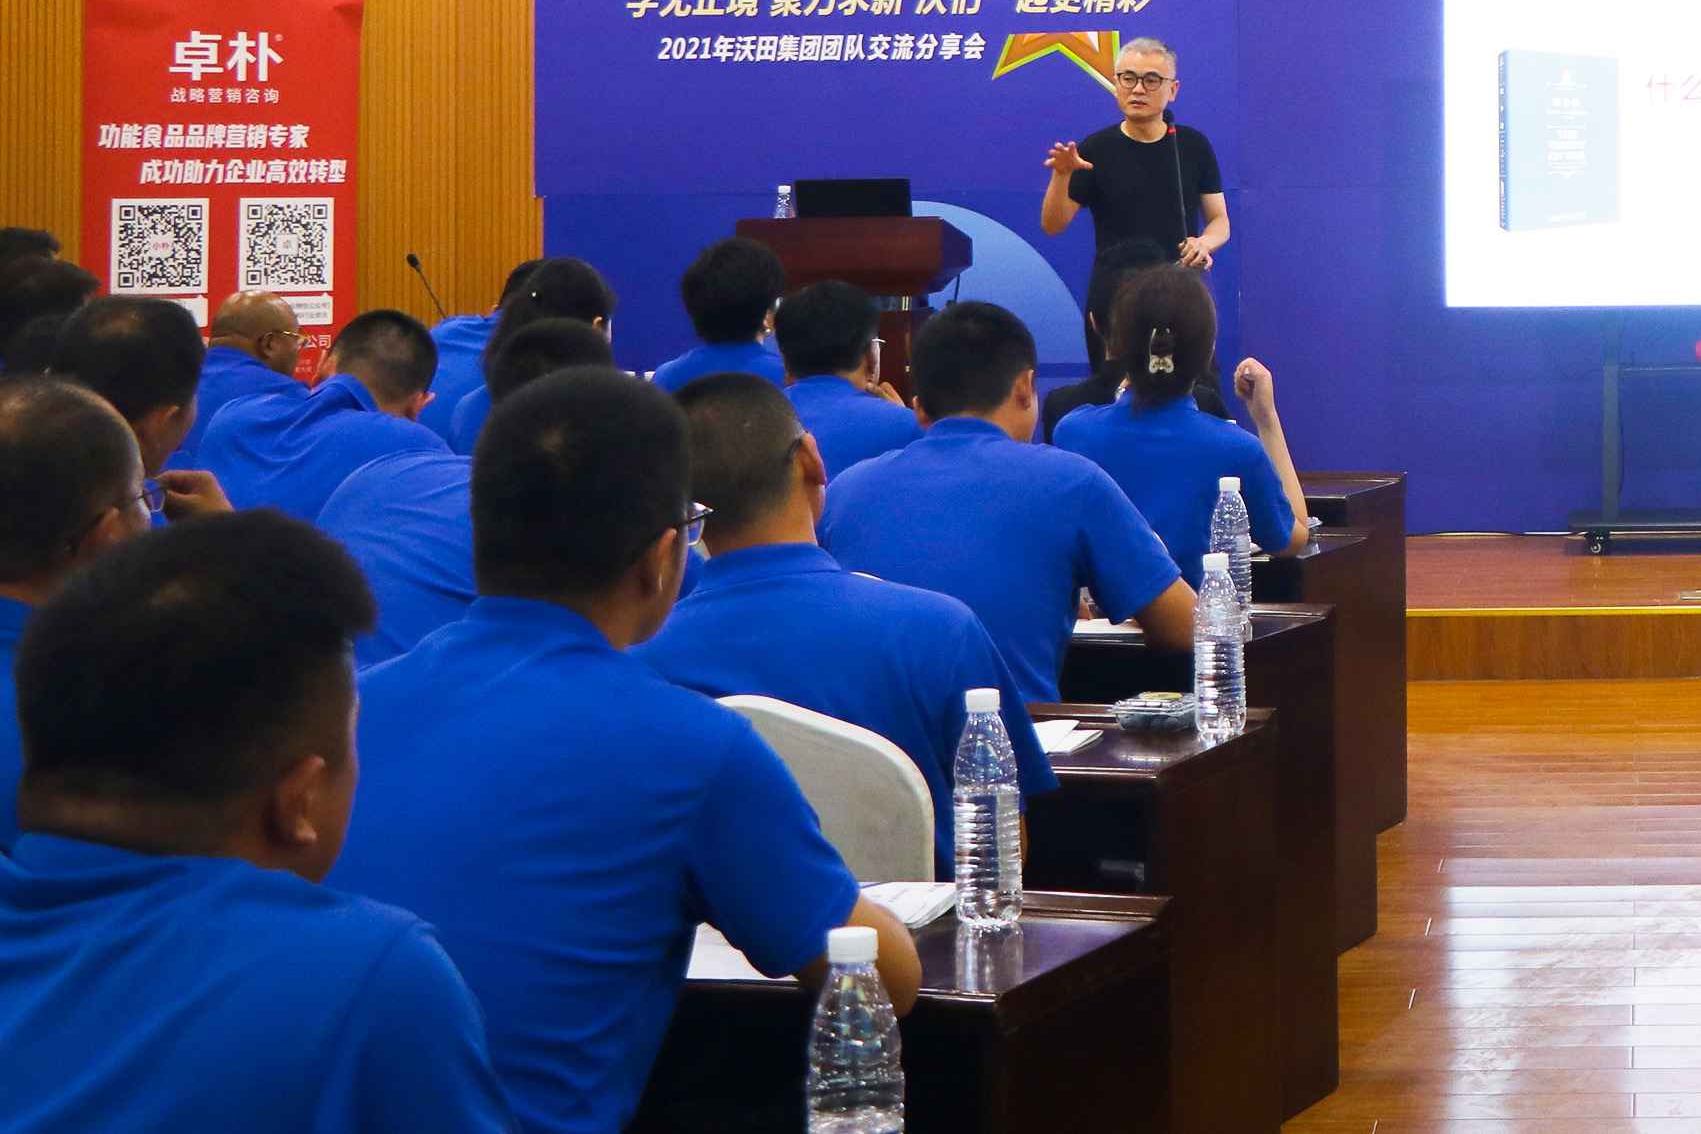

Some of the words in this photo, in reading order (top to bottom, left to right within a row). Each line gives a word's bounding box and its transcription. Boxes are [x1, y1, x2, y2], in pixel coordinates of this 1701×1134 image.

[169, 31, 284, 82] 卓朴
[657, 32, 987, 63] 2021年沃田集团团队交流分享会
[170, 87, 280, 104] 战略营销咨询
[98, 123, 310, 150] 功能食品品牌营销专家
[139, 158, 347, 185] 成功助力企业高效转型
[297, 334, 332, 349] 公司
